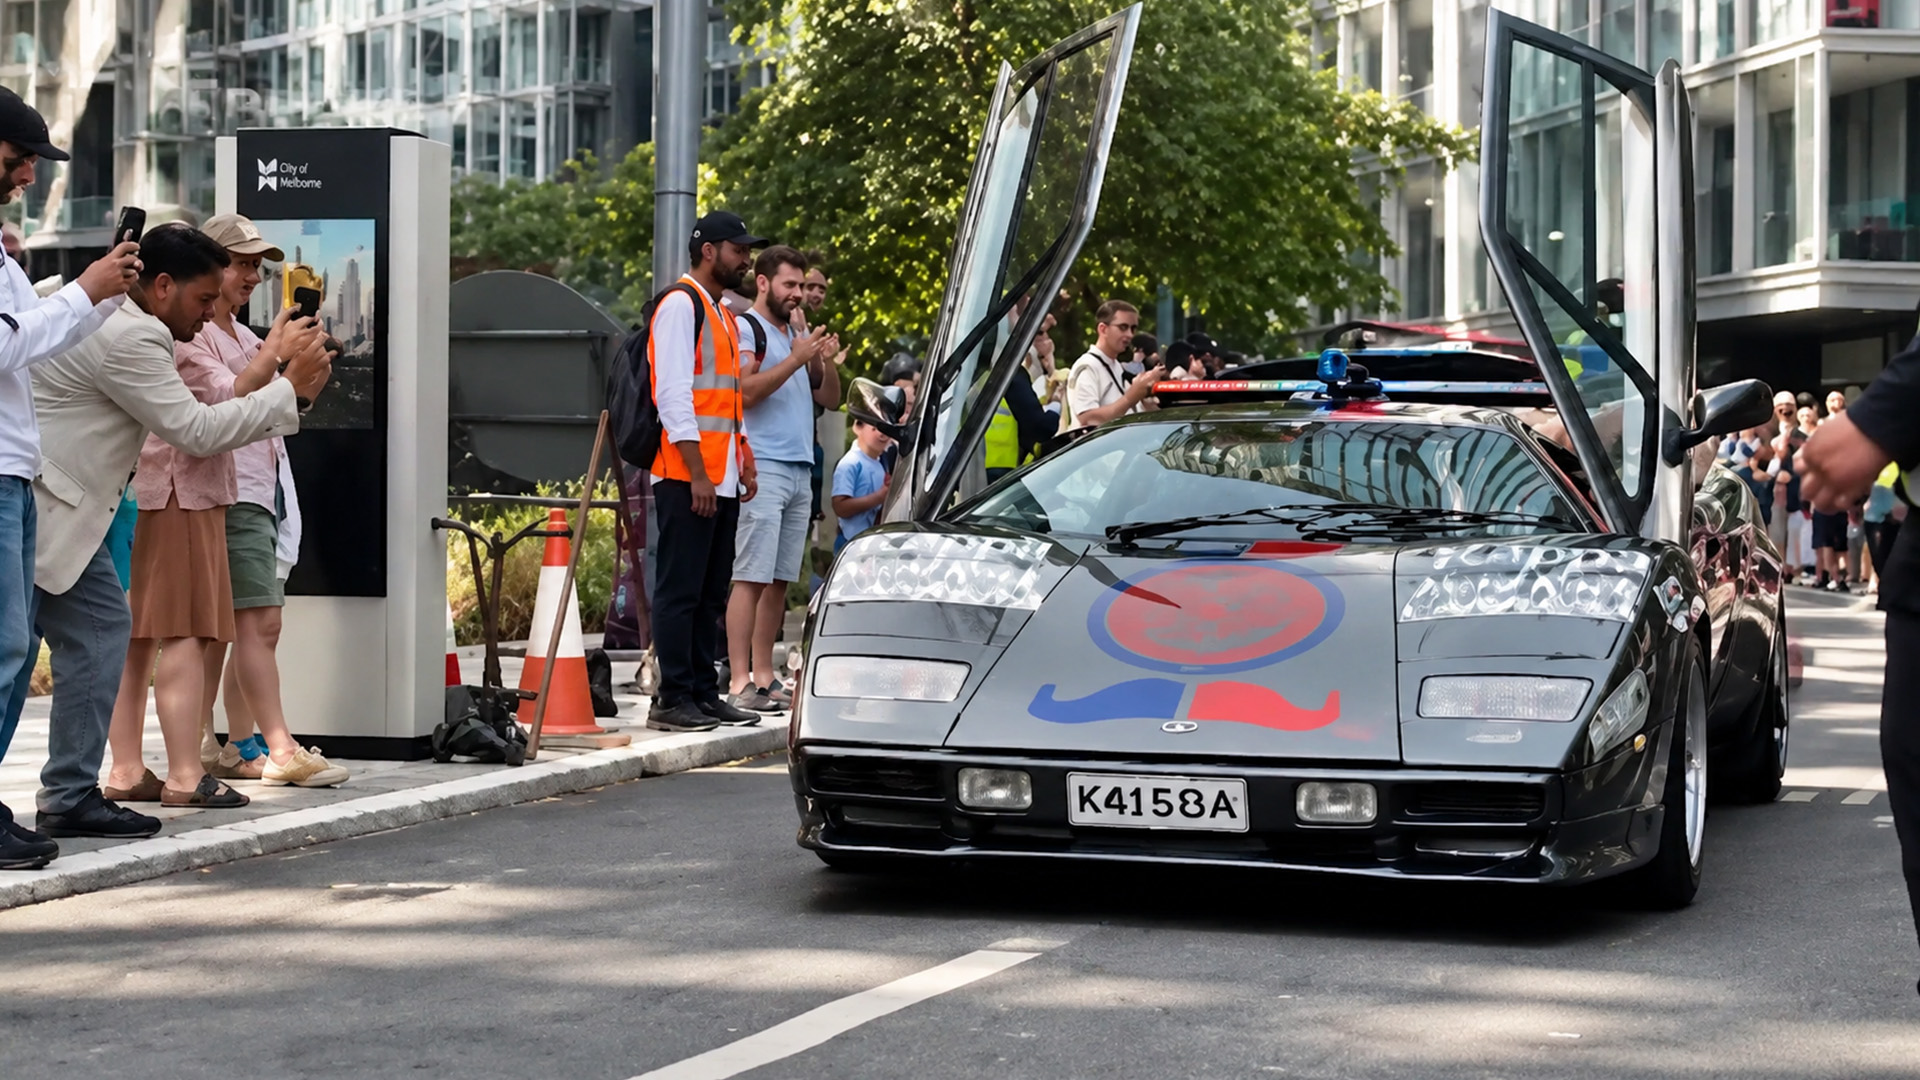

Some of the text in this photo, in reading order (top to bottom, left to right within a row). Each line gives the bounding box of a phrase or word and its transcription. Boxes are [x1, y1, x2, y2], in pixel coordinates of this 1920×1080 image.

[280, 162, 308, 176] City of
[1078, 785, 1237, 819] K4158A
